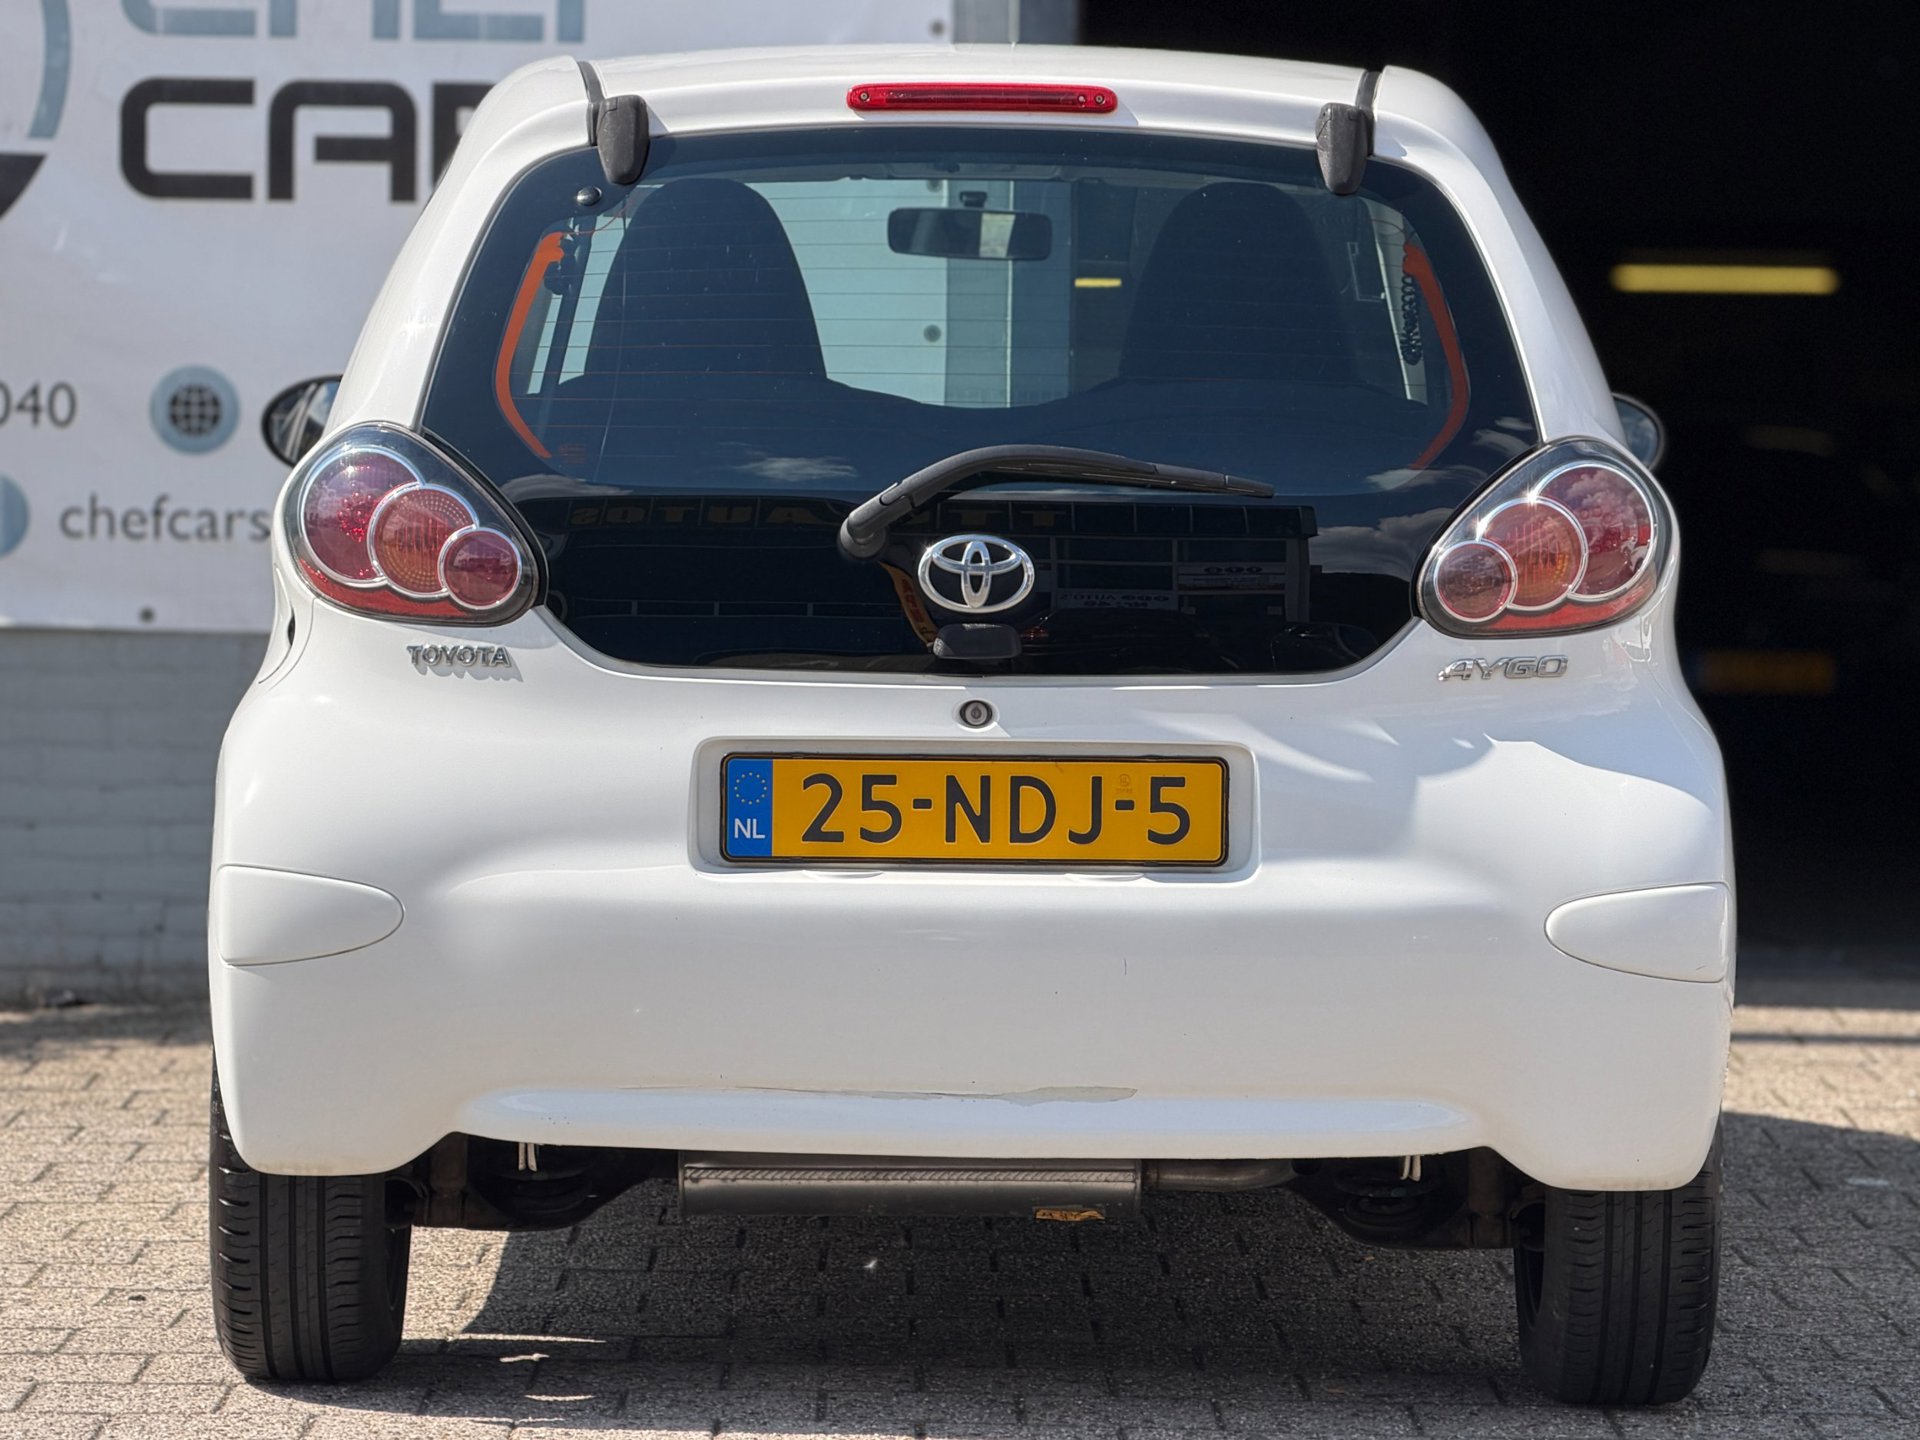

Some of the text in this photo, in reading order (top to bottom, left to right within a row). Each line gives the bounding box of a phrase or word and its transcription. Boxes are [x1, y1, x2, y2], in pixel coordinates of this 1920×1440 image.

[119, 77, 493, 203] CA
[59, 492, 272, 542] chefcars
[406, 644, 512, 668] TOYOTA
[1437, 654, 1569, 682] AYGO
[800, 772, 1191, 846] 25-NDJ-5
[733, 818, 766, 840] NL
